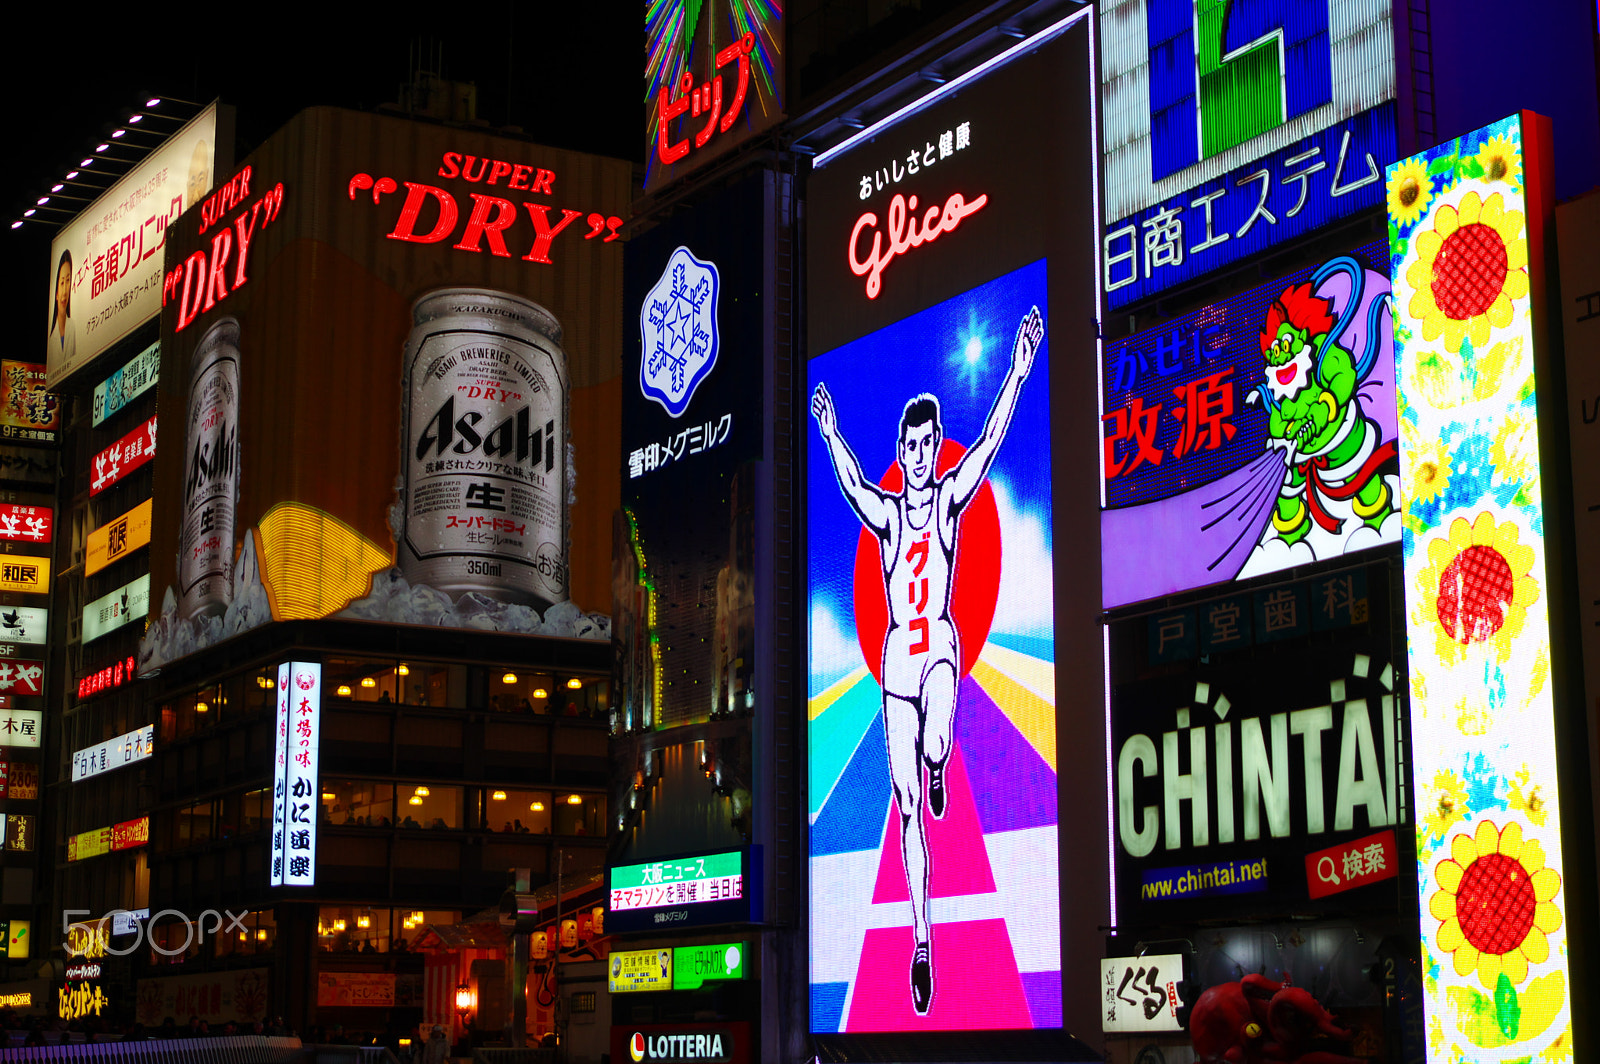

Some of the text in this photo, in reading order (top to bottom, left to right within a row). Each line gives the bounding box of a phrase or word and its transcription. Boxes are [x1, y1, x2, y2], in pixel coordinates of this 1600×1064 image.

[658, 31, 755, 165] ピップ
[438, 151, 556, 195] SUPER
[859, 121, 971, 200] おいしさと健康
[199, 165, 251, 235] SUPER
[1104, 130, 1379, 293] 日商エステム
[91, 194, 183, 300] 高須クリニック
[848, 193, 988, 300] Glico
[434, 347, 542, 394] ASAHI BREWERIES LIMITED
[1112, 322, 1222, 392] かぜに
[475, 379, 501, 387] SUPER
[3, 425, 17, 437] 9F
[416, 395, 554, 473] Asahi
[1101, 366, 1237, 479] 改源
[185, 419, 236, 504] Asahi
[628, 413, 732, 479] 雪印メグミルク
[466, 482, 506, 512] 生
[109, 522, 127, 556] 和民
[201, 506, 214, 535] 生
[446, 515, 526, 536] スーパードライ
[466, 532, 502, 546] 生ビール
[4, 566, 36, 581] 和民
[467, 560, 502, 578] 350ml
[538, 553, 564, 586] お酒
[905, 531, 931, 656] グリコ
[1157, 575, 1357, 655] 戸堂歯科
[2, 718, 36, 735] 木屋
[295, 697, 313, 768] 本場の味
[80, 748, 107, 777] 白木屋
[125, 732, 153, 762] 白木屋
[1118, 665, 1405, 858] CHINTAI
[10, 772, 38, 788] 280円
[641, 859, 706, 885] 大阪ニュース
[1142, 857, 1268, 899] ww.chintai.net
[1342, 843, 1386, 881] 検索
[610, 876, 743, 910] 子マラソンを開催！当日は
[654, 911, 688, 923] 雪印メグミルク
[59, 980, 109, 1021] びっくりドンキー
[1117, 966, 1167, 1020] くくる
[1384, 957, 1396, 1007] 2F
[648, 1034, 724, 1058] LOTTERIA
